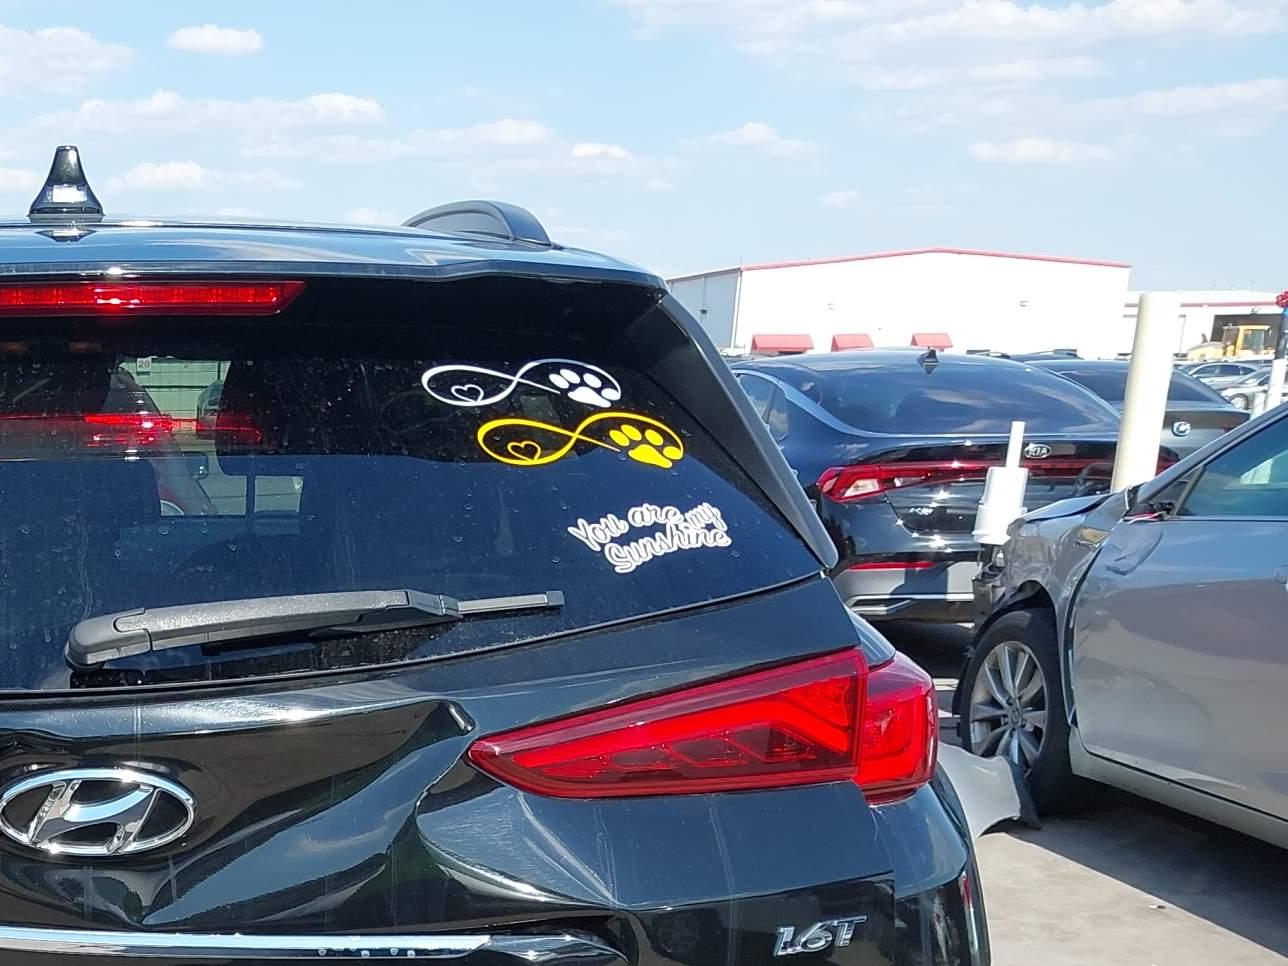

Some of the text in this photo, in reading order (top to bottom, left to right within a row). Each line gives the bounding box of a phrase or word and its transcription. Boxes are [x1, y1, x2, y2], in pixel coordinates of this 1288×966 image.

[568, 502, 727, 551] You are my
